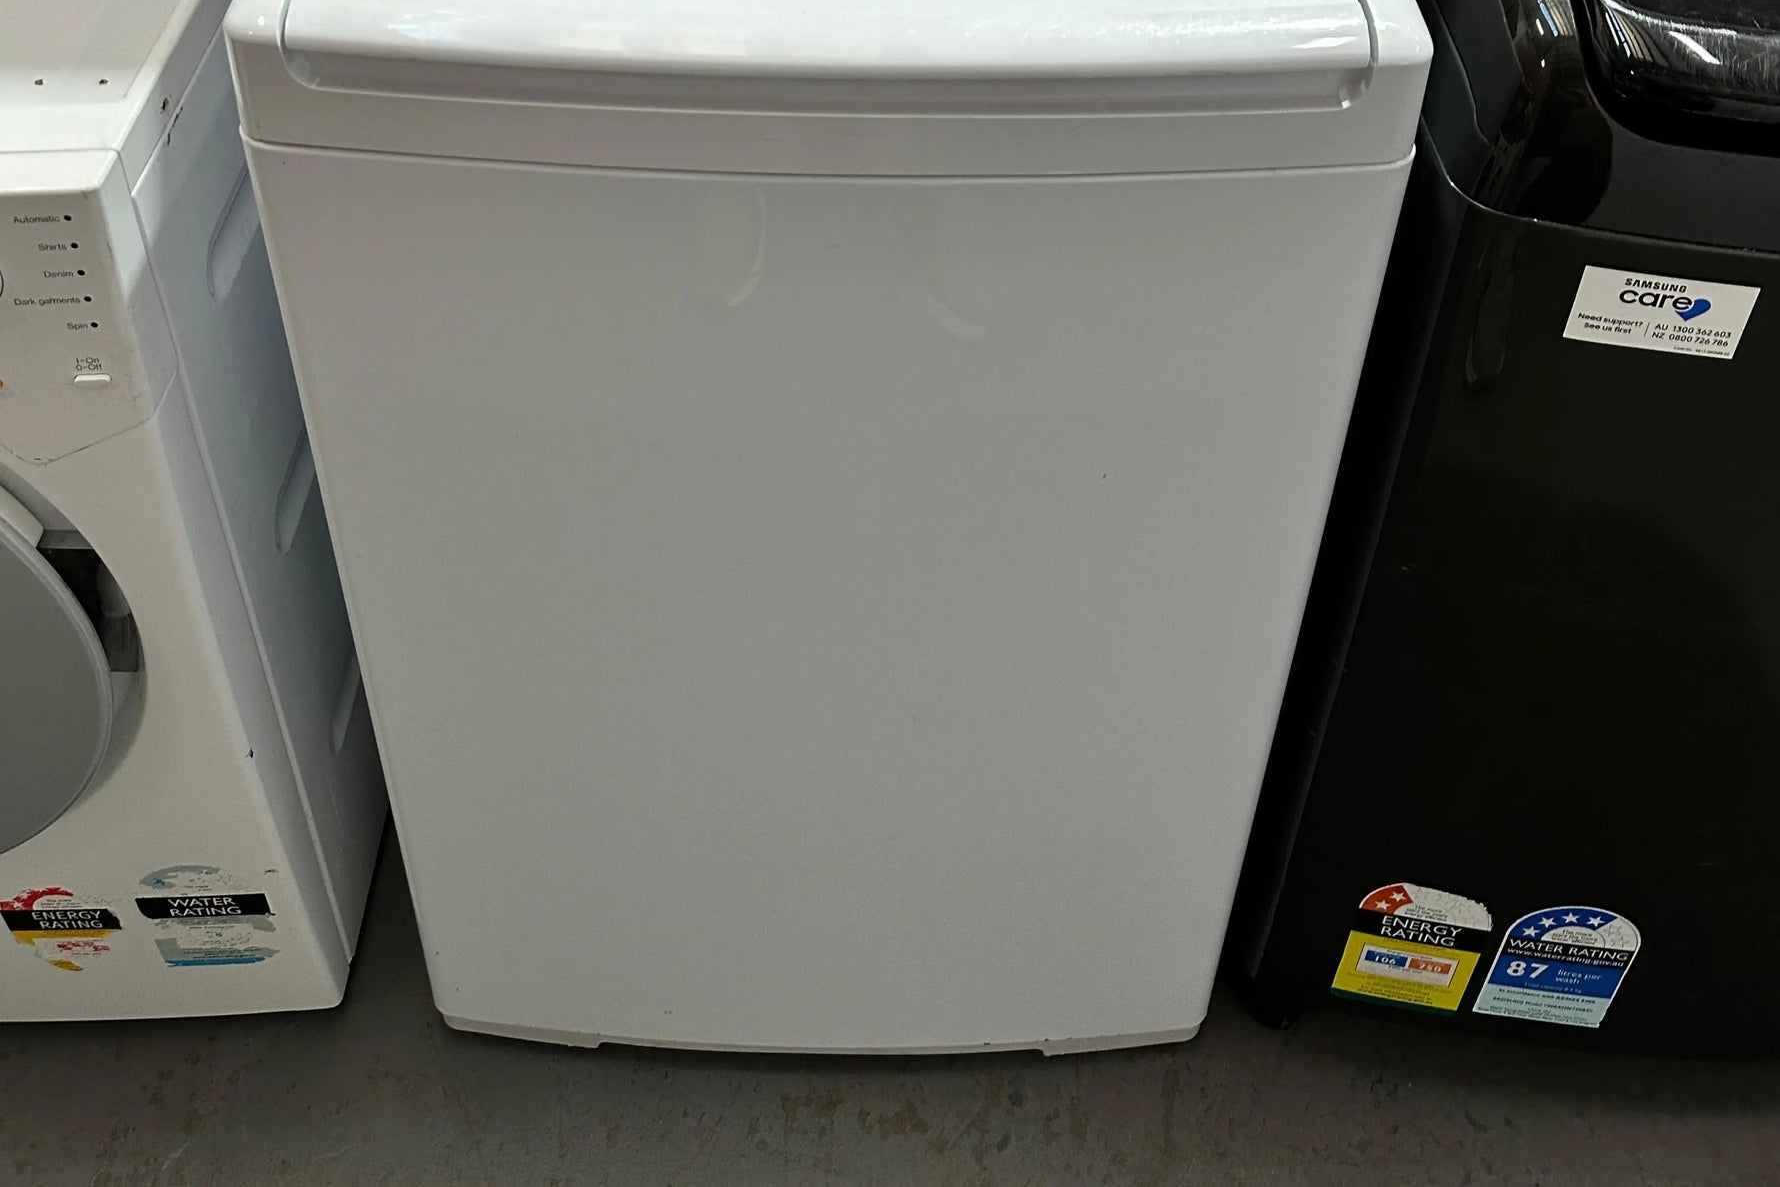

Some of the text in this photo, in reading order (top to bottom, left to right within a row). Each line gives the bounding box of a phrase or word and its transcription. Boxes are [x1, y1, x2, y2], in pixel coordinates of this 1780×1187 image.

[13, 216, 60, 224] Automatic
[38, 243, 67, 251] Shirts
[43, 270, 74, 279] Denim
[1625, 278, 1687, 293] SAMSUNG
[39, 297, 81, 306] garments
[1618, 289, 1693, 311] care
[67, 321, 88, 330] Spin
[1577, 312, 1644, 328] Need support?
[1583, 322, 1632, 334] See us first
[1654, 323, 1732, 338] AU 1300 362 603
[1651, 331, 1729, 347] NZ 0800 726 786
[168, 897, 236, 907] WATER
[32, 910, 101, 921] ENERGY
[170, 906, 241, 916] RATING
[40, 920, 103, 929] RATING
[1382, 915, 1462, 937] ENERGY
[1380, 926, 1456, 947] RATING
[1509, 938, 1563, 954] WATER
[1568, 947, 1630, 961] RATING
[1374, 955, 1397, 965] 106
[1507, 948, 1624, 968] www.waterrating.gov.au
[1506, 960, 1549, 979] 87
[1557, 968, 1582, 978] litres
[1555, 976, 1580, 985] wash
